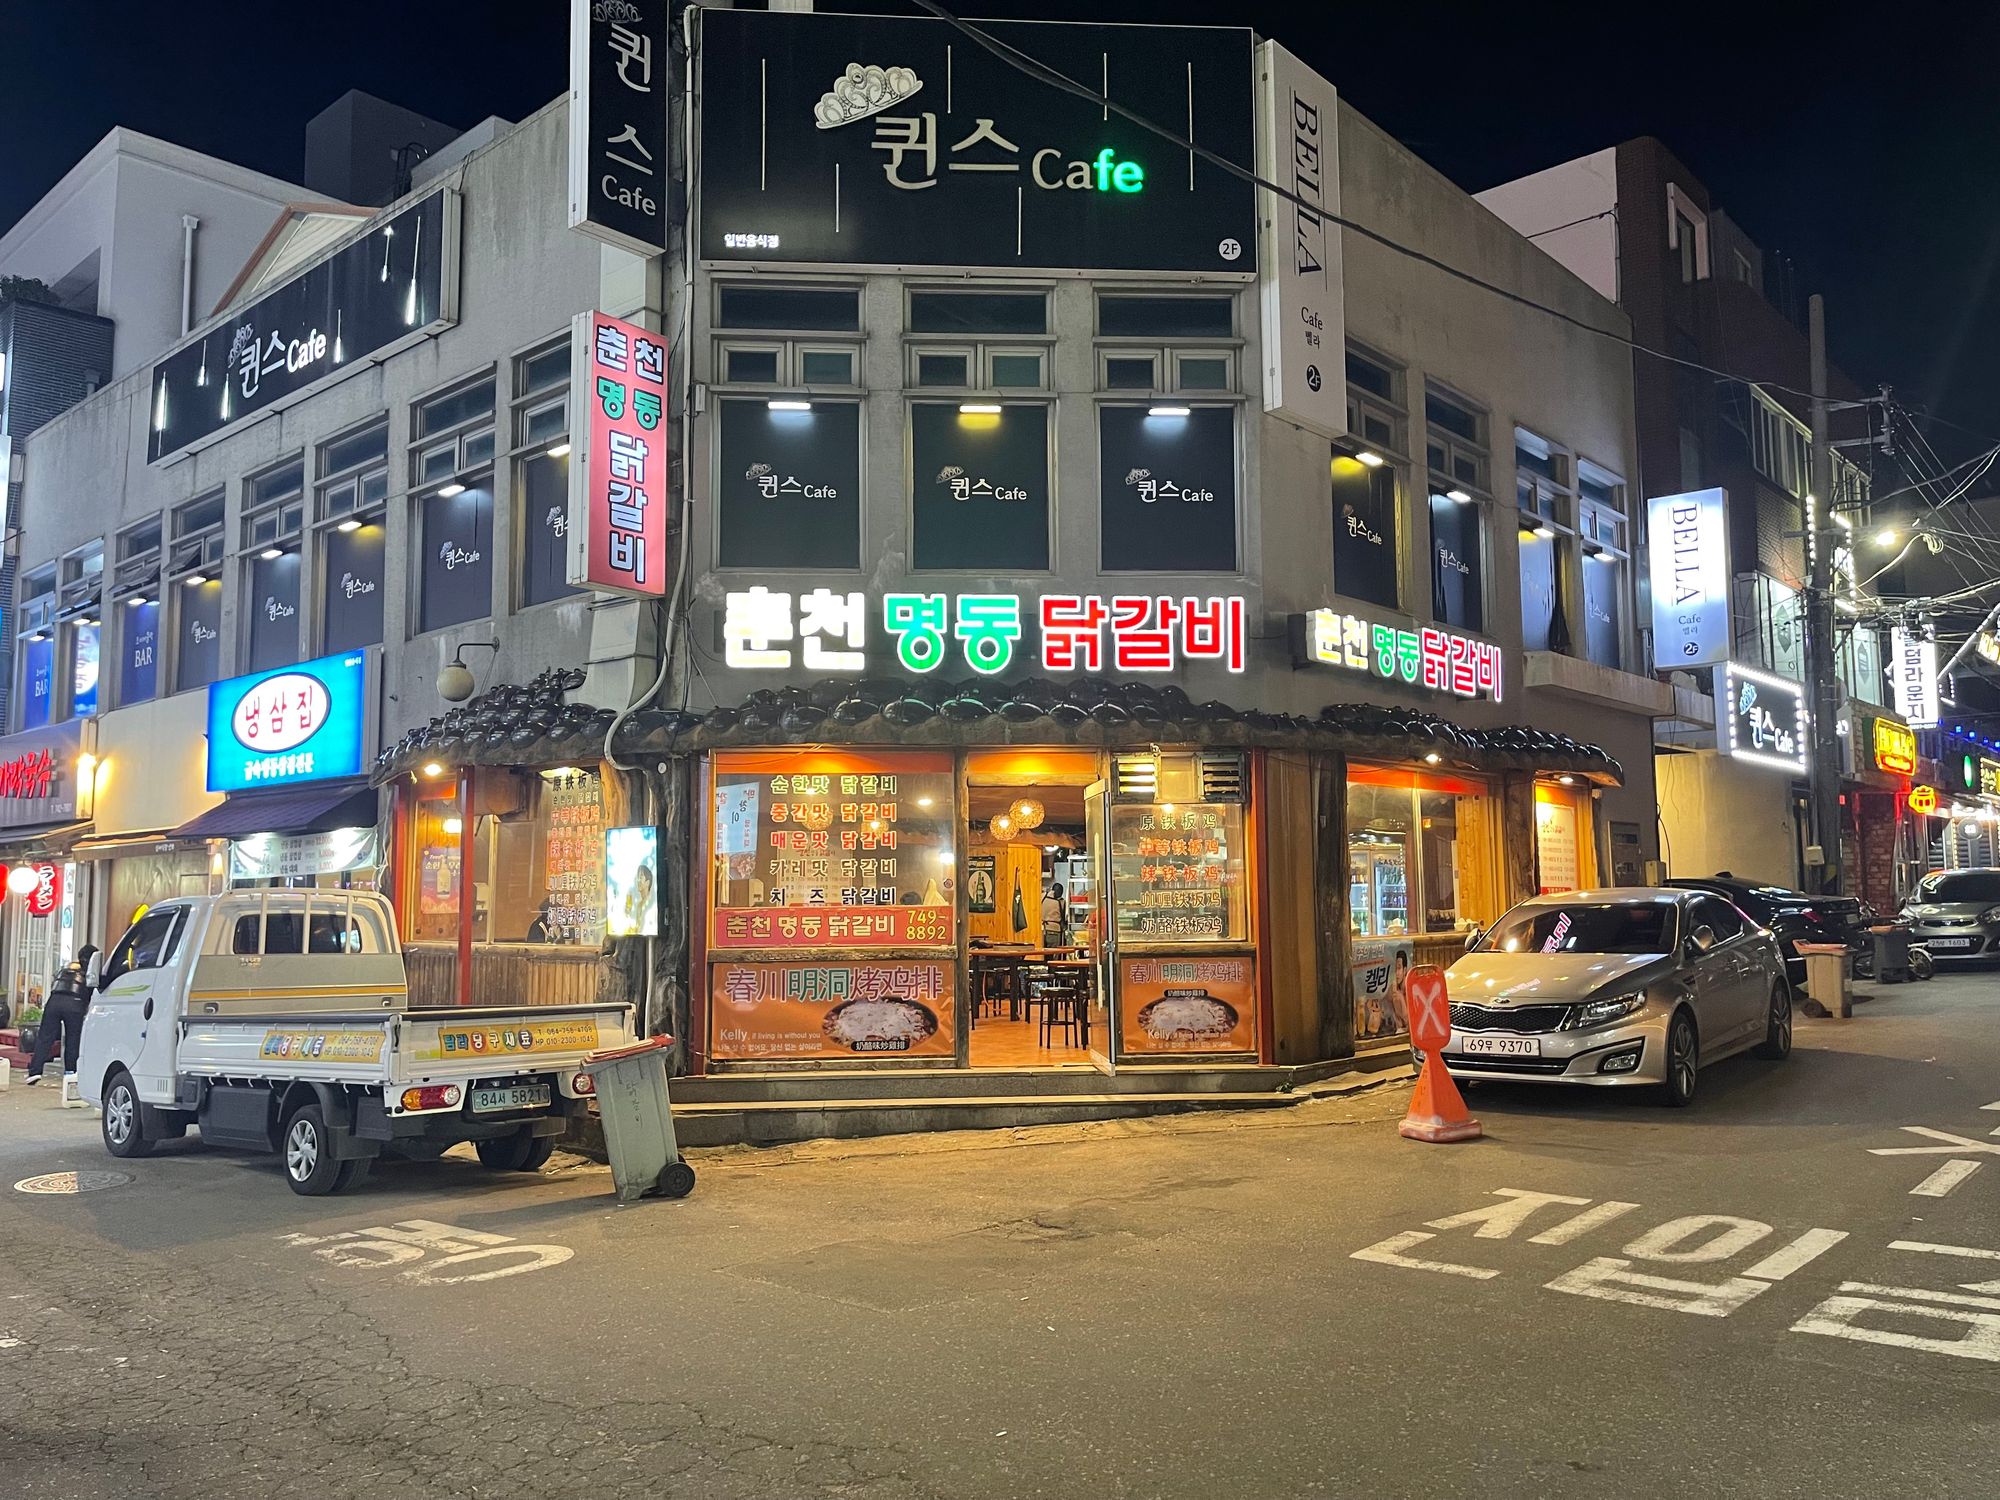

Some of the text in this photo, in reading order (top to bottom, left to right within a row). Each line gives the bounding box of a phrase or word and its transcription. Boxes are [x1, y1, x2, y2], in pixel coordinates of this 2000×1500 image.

[606, 22, 653, 176] 퀸스
[870, 112, 1144, 193] 퀸스 Cafe
[601, 174, 657, 216] Cafe
[1293, 90, 1323, 278] BELLA
[724, 233, 779, 249] 일반음식점
[1221, 243, 1239, 255] 2F
[1301, 306, 1323, 331] Cafe
[239, 329, 327, 398] 퀸스 Cafe
[596, 324, 664, 386] 춘천
[597, 375, 662, 431] 명동
[758, 474, 837, 500] 퀸스 Cafe
[950, 477, 1027, 501] 퀸스 Cafe
[1137, 479, 1214, 503] 퀸스 Cafe
[608, 429, 650, 584] 닭갈비
[1347, 515, 1382, 545] 퀸스 Cafe
[446, 548, 480, 570] 퀸스 Cafe
[1439, 548, 1456, 568] 퀸스
[1672, 504, 1701, 605] BELLA
[346, 579, 375, 598] 퀸스 Cafe
[724, 586, 1245, 674] 춘천 명동 닭갈비
[1678, 614, 1701, 625] Cafe
[135, 647, 153, 668] BAR
[1315, 607, 1504, 702] 춘천 명동 닭갈비
[1685, 643, 1698, 654] 2F
[35, 679, 49, 697] BAR
[245, 685, 313, 738] 냉삼집
[1750, 706, 1794, 754] 퀸스 Cafe
[770, 775, 897, 794] 순한맛 닭갈비
[770, 803, 897, 822] 중간맛 닭갈비
[1140, 813, 1217, 831] 原铁板鸡
[770, 831, 829, 850] 매운맛
[840, 831, 897, 850] 닭갈비
[1138, 838, 1220, 857] 中等铁板鸡
[769, 858, 897, 878] 카레맛 닭갈비
[840, 887, 897, 906] 닭갈비
[725, 915, 895, 938] 춘천 명동 닭갈비
[907, 910, 947, 924] 749-
[1141, 916, 1223, 935] 奶酪铁板鸡
[906, 925, 947, 940] 8892
[726, 966, 944, 1002] 春川明洞烤鸡排
[1130, 962, 1244, 984] 春川明洞烤鸡排
[1365, 964, 1391, 993] 켈리
[784, 1032, 807, 1040] without
[809, 1032, 820, 1041] you
[1469, 1039, 1532, 1053] 69무 9370
[512, 1088, 541, 1104] 5821
